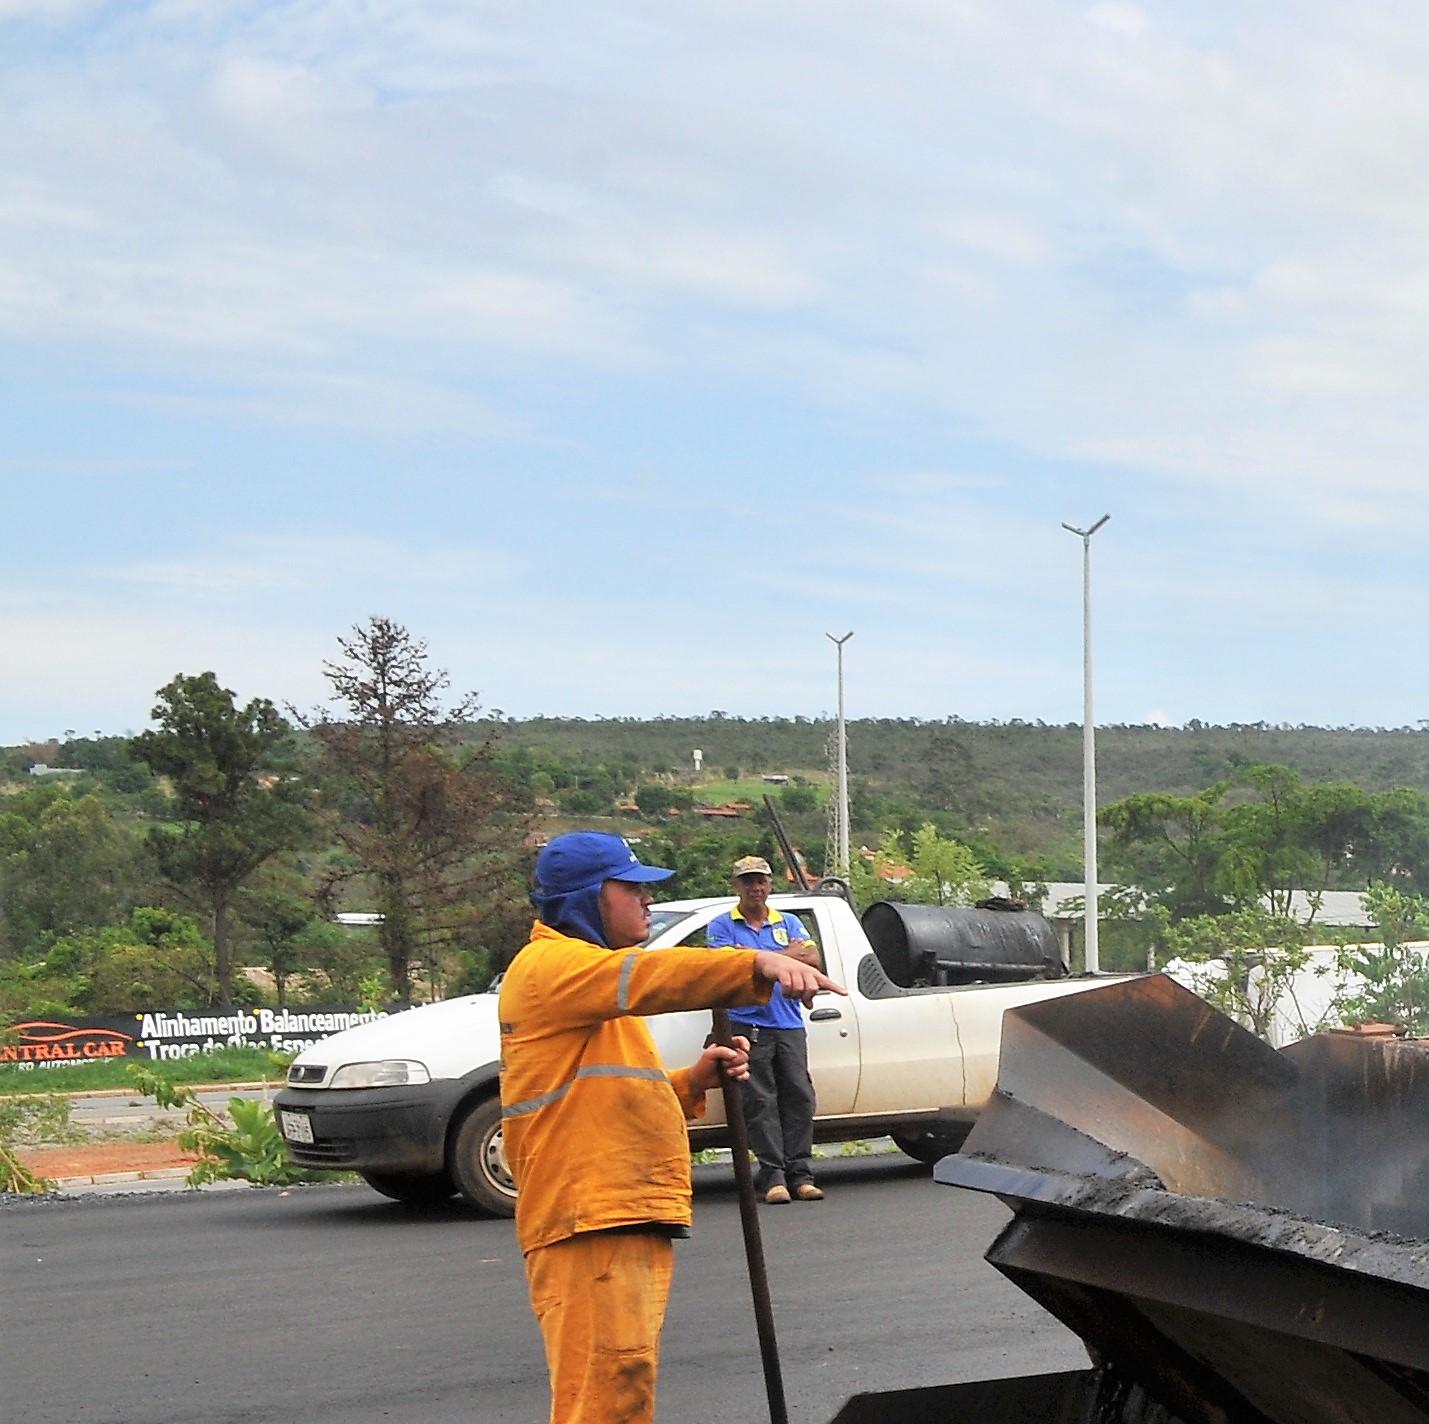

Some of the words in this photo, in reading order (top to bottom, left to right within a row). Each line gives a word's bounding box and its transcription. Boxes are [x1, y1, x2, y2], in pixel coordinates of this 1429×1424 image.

[141, 1010, 257, 1038] Alinhamento
[0, 1043, 81, 1061] NTRAL
[83, 1041, 126, 1058] CAR
